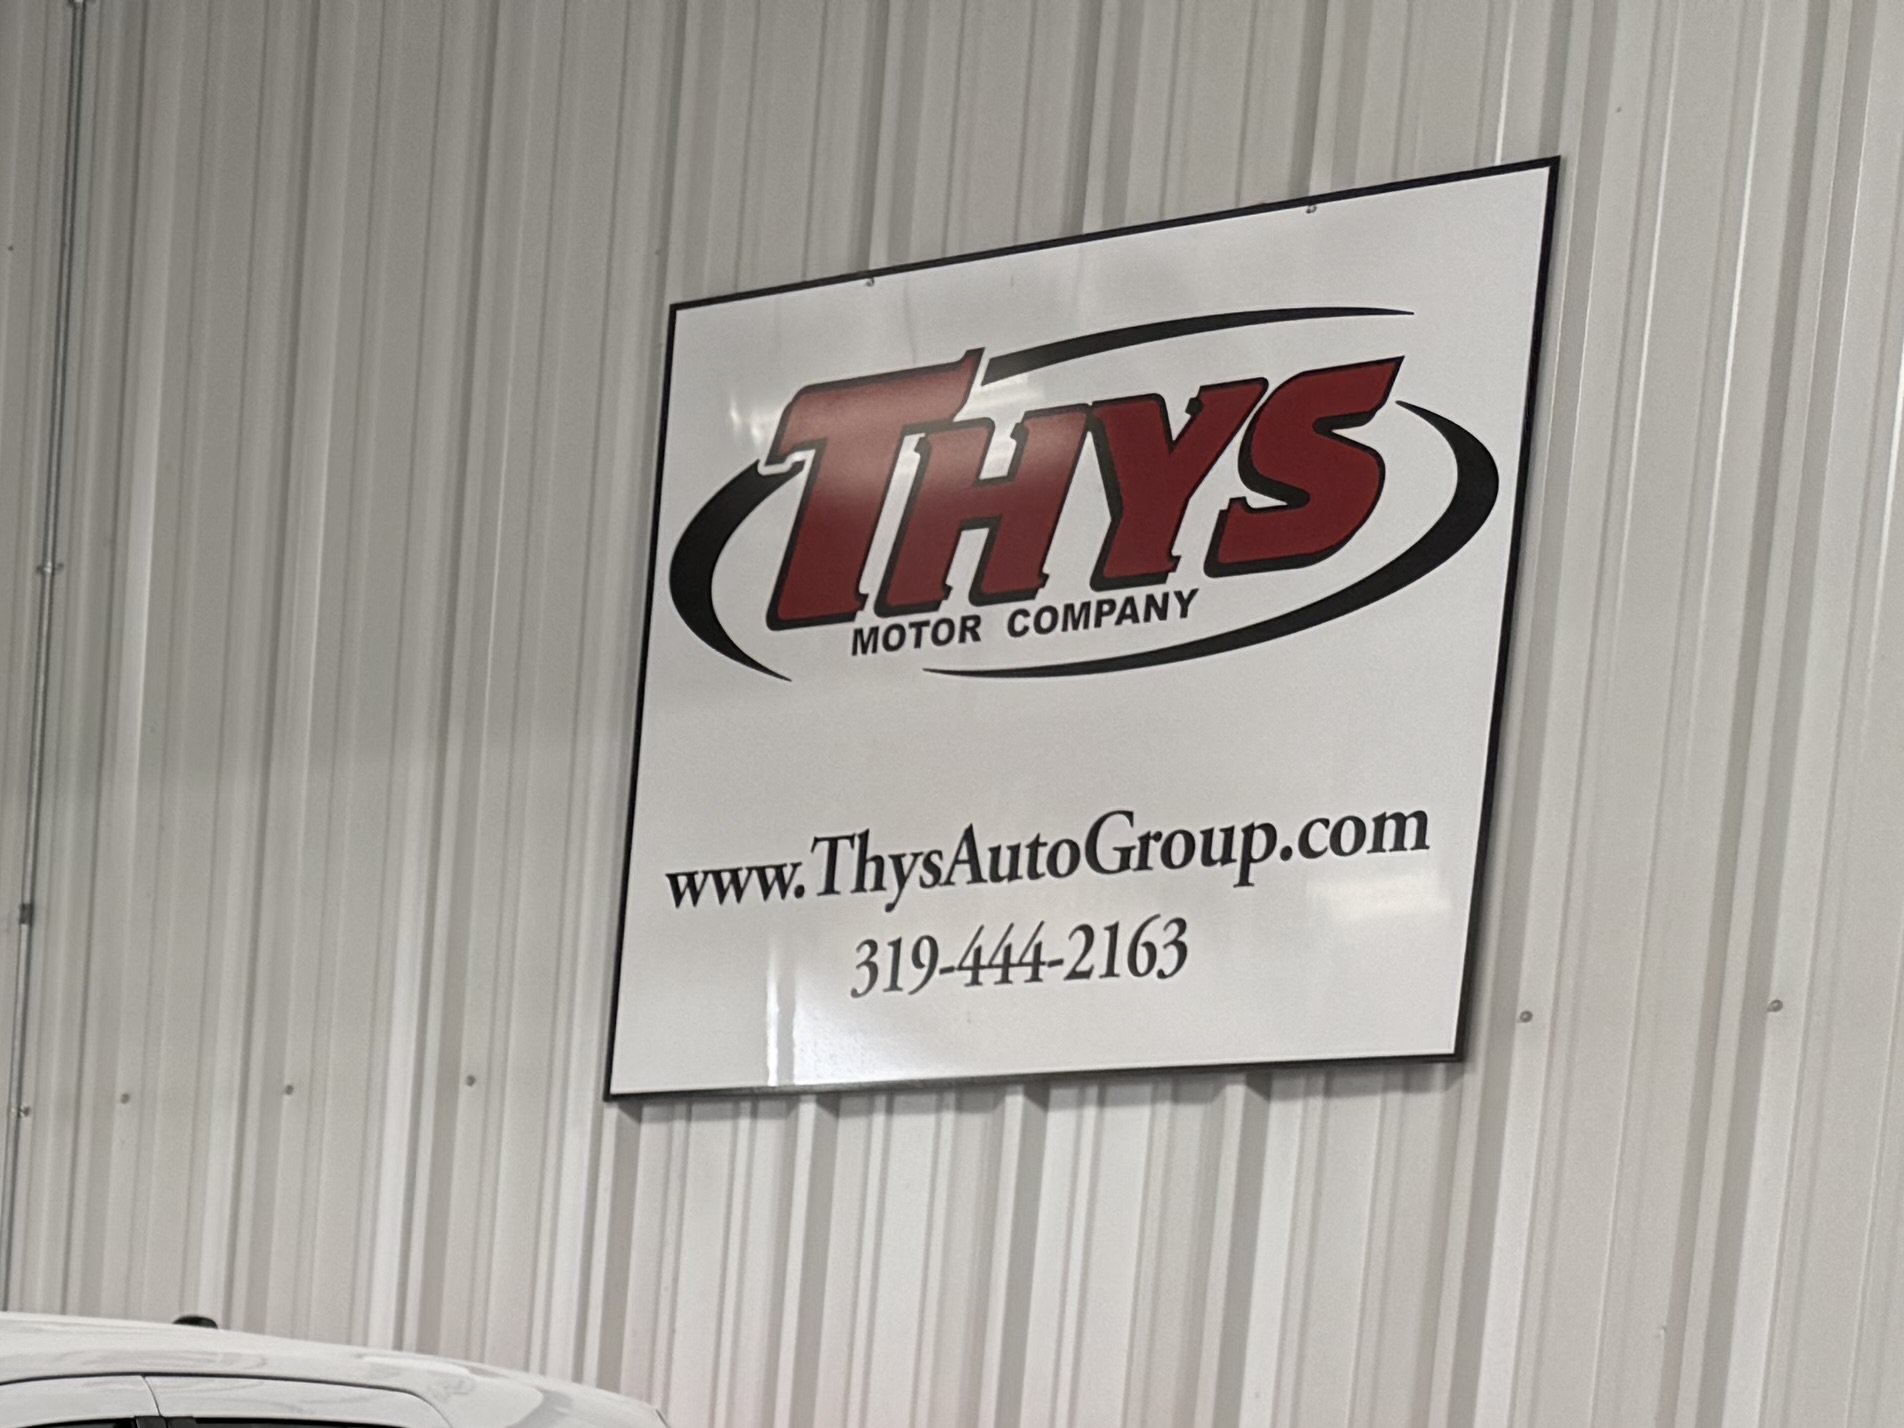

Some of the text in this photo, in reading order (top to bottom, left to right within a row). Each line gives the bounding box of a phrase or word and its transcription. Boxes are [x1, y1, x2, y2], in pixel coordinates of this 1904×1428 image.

[764, 347, 1405, 630] THYS
[850, 588, 1199, 656] MOTOR COMPANY
[665, 810, 1430, 912] www.ThysAutoGroup.com
[850, 914, 1188, 998] 319-444-2163
